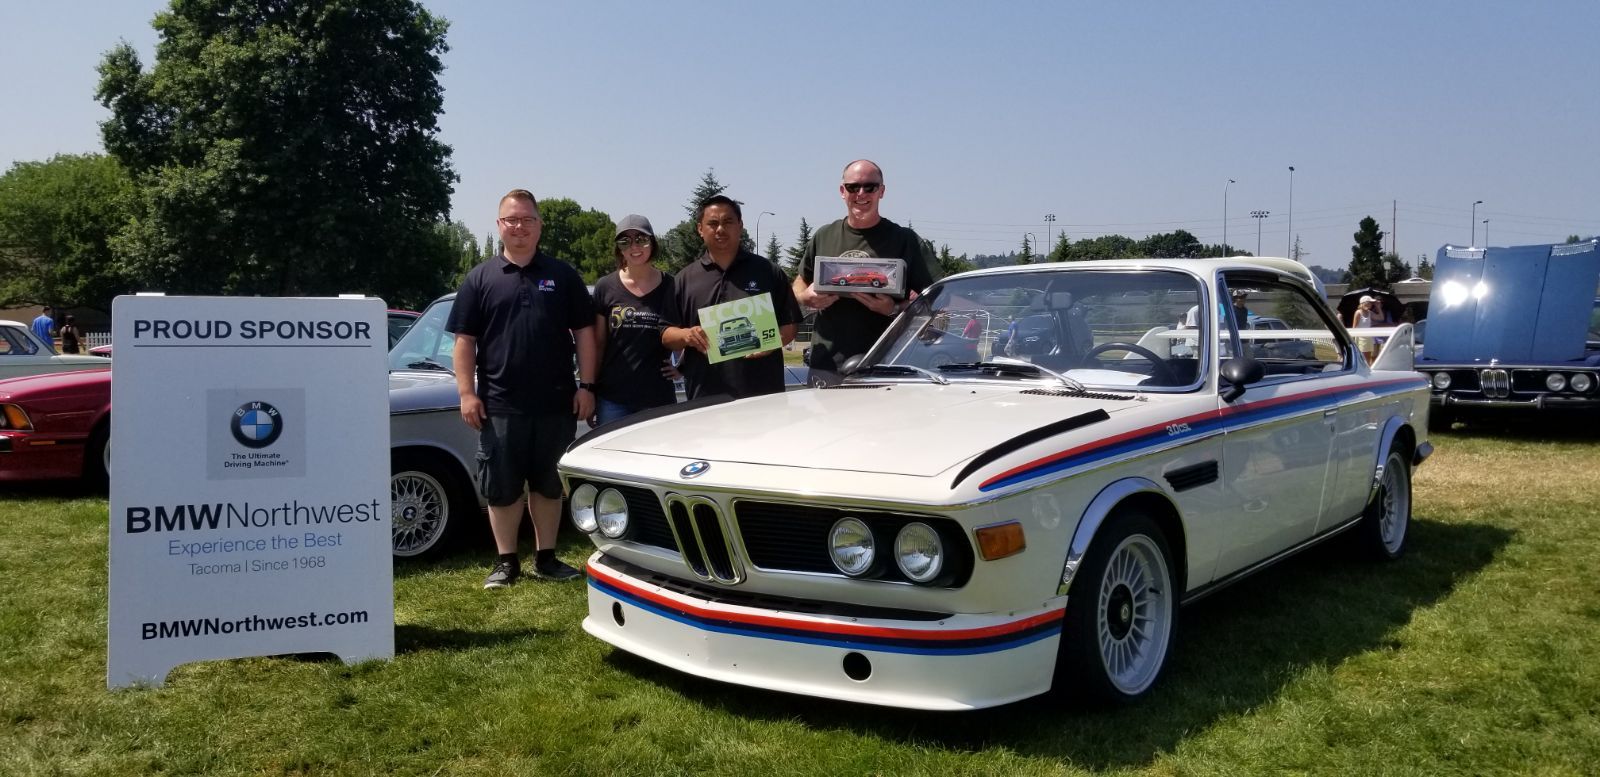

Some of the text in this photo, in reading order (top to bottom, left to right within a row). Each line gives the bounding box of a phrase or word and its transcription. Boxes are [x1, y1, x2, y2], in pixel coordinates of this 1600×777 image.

[698, 292, 774, 328] ICON
[133, 319, 371, 340] PROUD SPONSOR
[762, 327, 776, 340] 50
[236, 402, 278, 417] BMW
[224, 461, 252, 469] Driving
[126, 498, 380, 534] BMWNorthwest
[168, 532, 343, 558] Experience the Best
[187, 561, 241, 576] Tacoma
[251, 558, 290, 572] Since
[292, 556, 326, 569] 1968
[141, 609, 368, 640] BMWNorthwest.com
